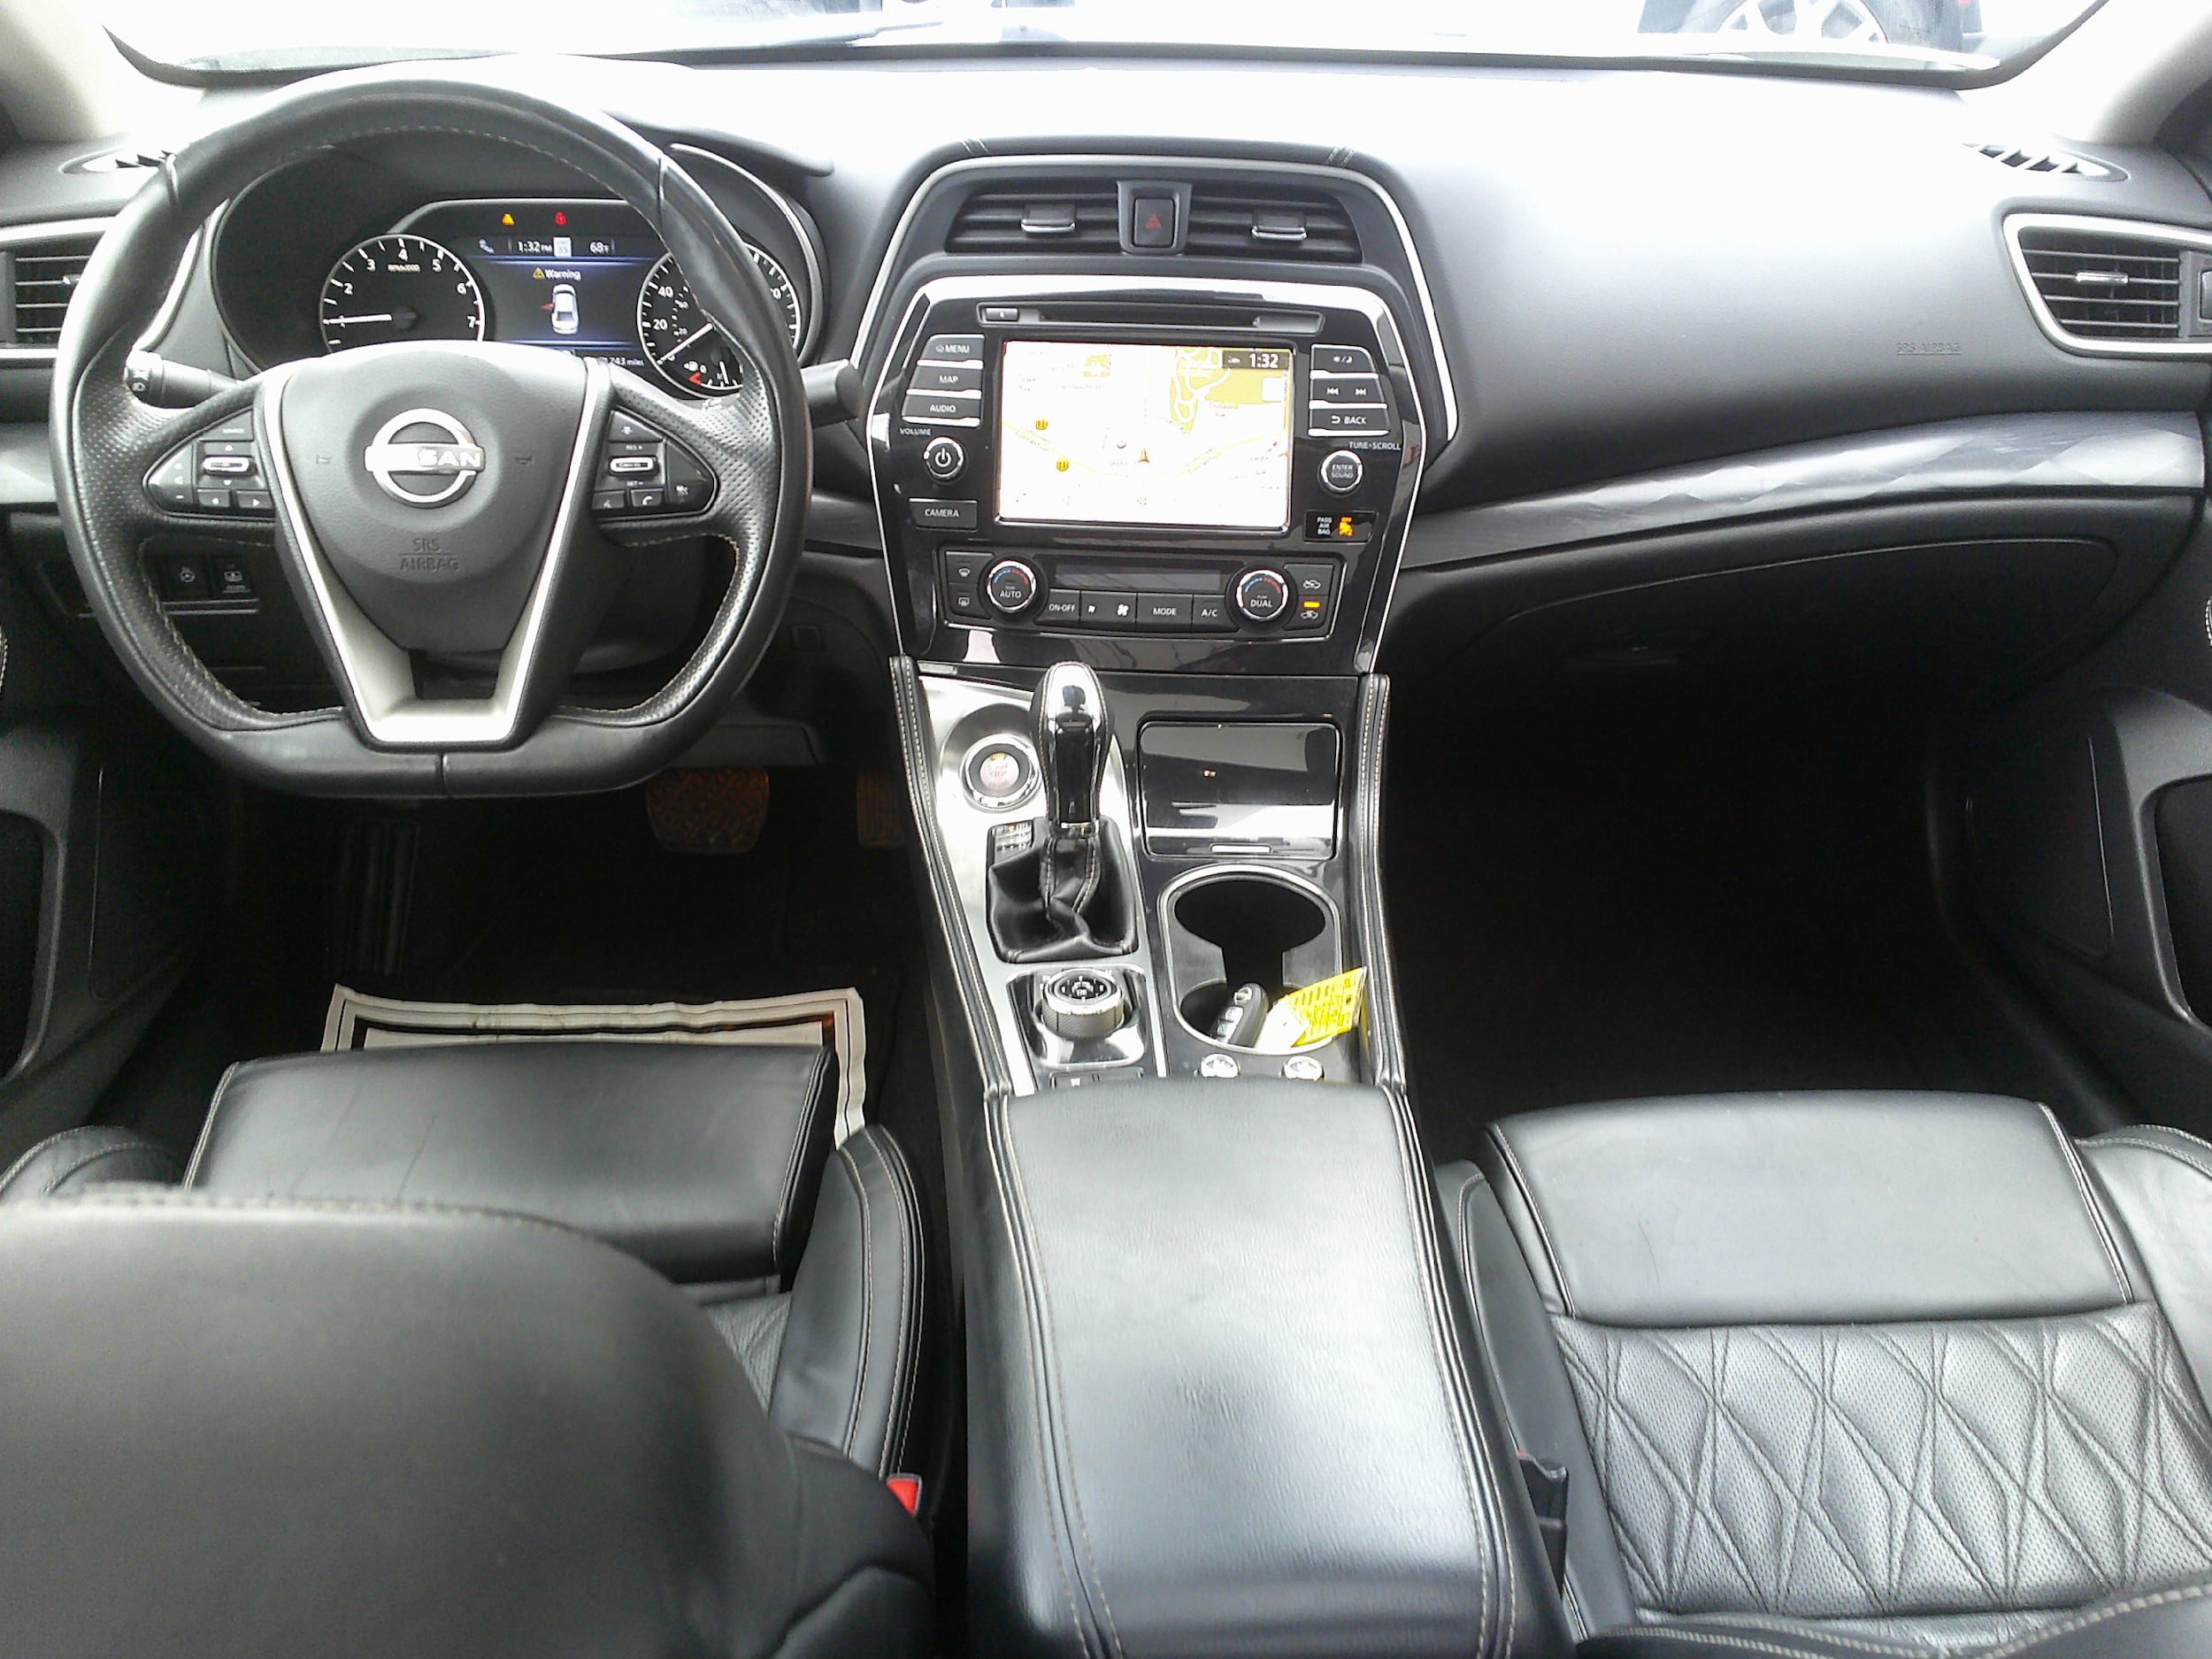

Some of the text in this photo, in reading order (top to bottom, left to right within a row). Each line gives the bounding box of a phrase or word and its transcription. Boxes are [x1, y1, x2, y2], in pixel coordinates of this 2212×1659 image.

[398, 249, 408, 261] 4
[366, 258, 376, 272] 3
[433, 258, 442, 272] 5
[544, 268, 582, 281] Warning
[343, 282, 354, 296] 2
[456, 282, 467, 296] 6
[657, 286, 674, 299] 40
[466, 316, 476, 328] 7
[653, 319, 668, 331] 20
[944, 344, 970, 354] MENU
[1248, 353, 1279, 369] 1:32
[939, 375, 959, 384] MAP
[929, 403, 956, 413] AUDIO
[1343, 416, 1367, 426] BACK
[899, 427, 931, 436] VOLUME
[924, 508, 961, 518] CAMERA
[412, 536, 442, 552] SRS
[399, 557, 459, 572] AIRBAG
[999, 590, 1022, 599] AUTO
[1250, 599, 1273, 609] DUAL
[1152, 607, 1178, 616] MODE
[1201, 609, 1218, 618] A/C
